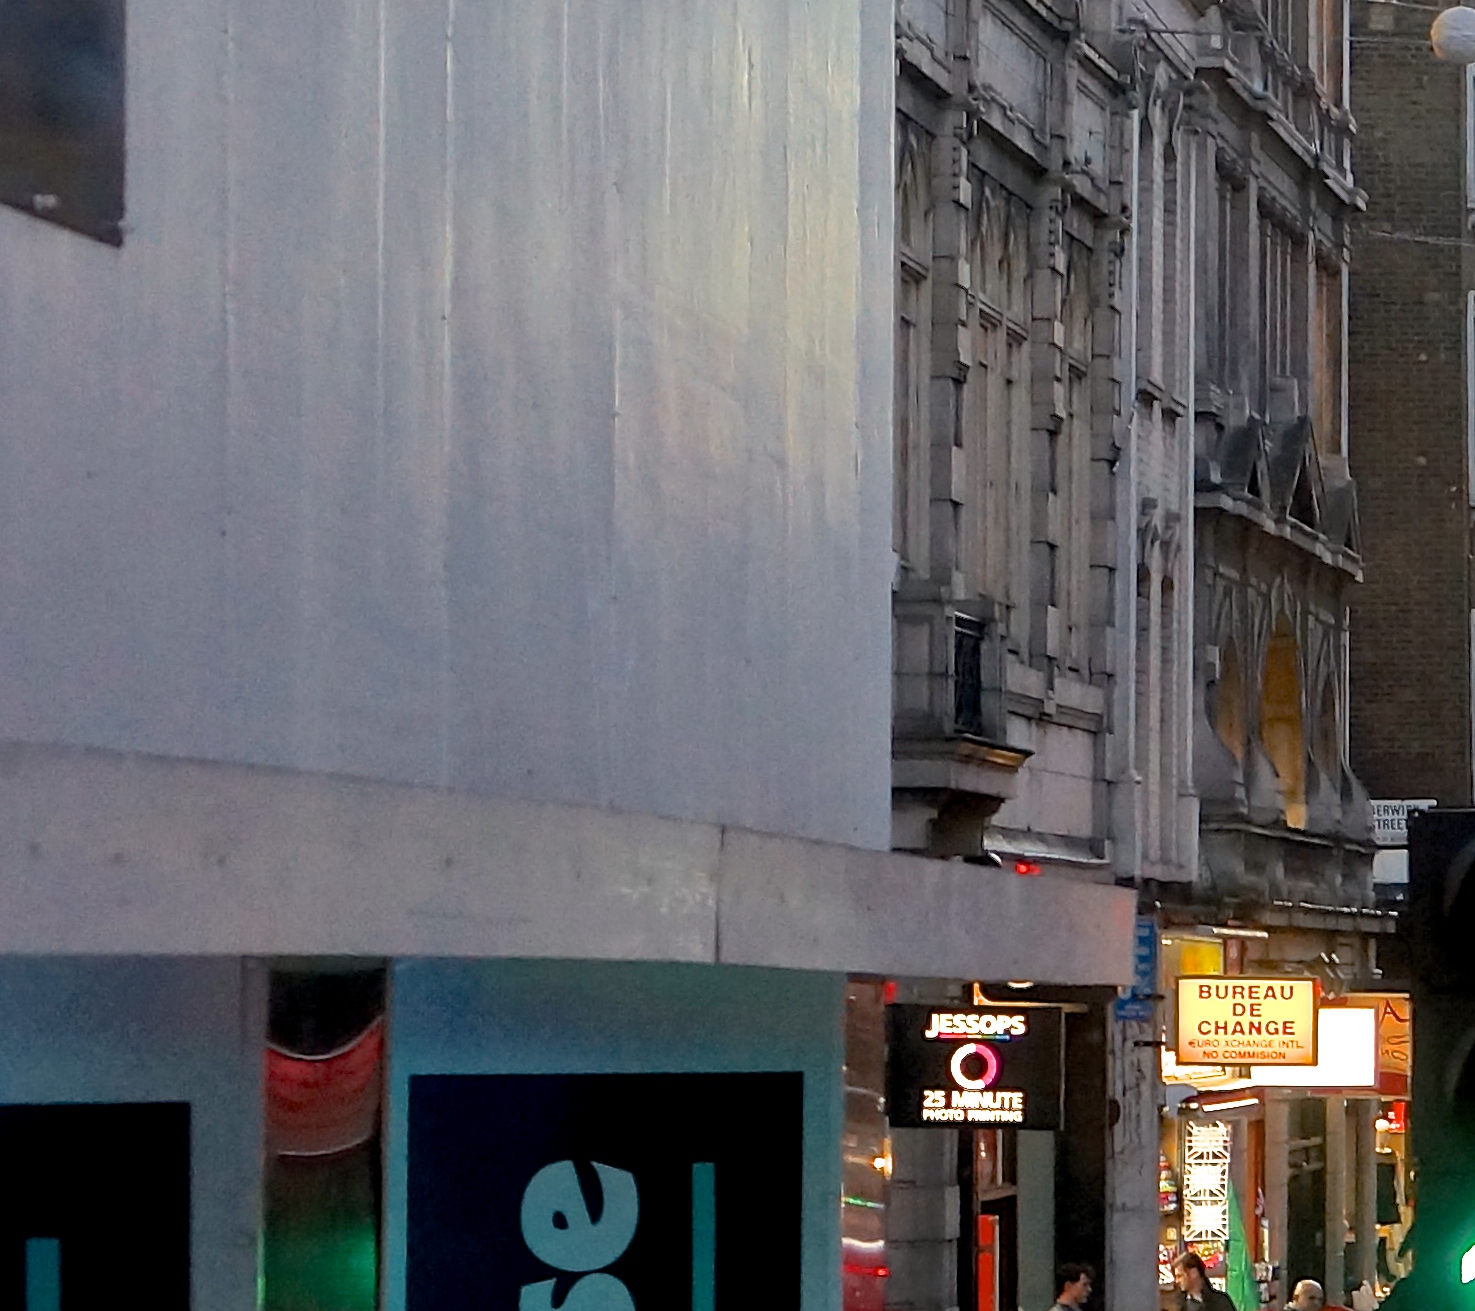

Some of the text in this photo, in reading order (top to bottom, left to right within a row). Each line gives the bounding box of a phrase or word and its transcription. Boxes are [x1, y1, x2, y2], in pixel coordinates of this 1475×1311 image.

[1198, 984, 1295, 1000] BUREAU
[1231, 1002, 1263, 1017] DE
[924, 1013, 1027, 1038] JESSOPS
[1197, 1020, 1296, 1036] CHANGE
[1223, 1038, 1275, 1049] XCHANGE
[1203, 1050, 1287, 1061] NO COMMISION
[922, 1089, 1024, 1109] 25 MINUTE
[922, 1108, 1023, 1123] PHOTO PRINTING
